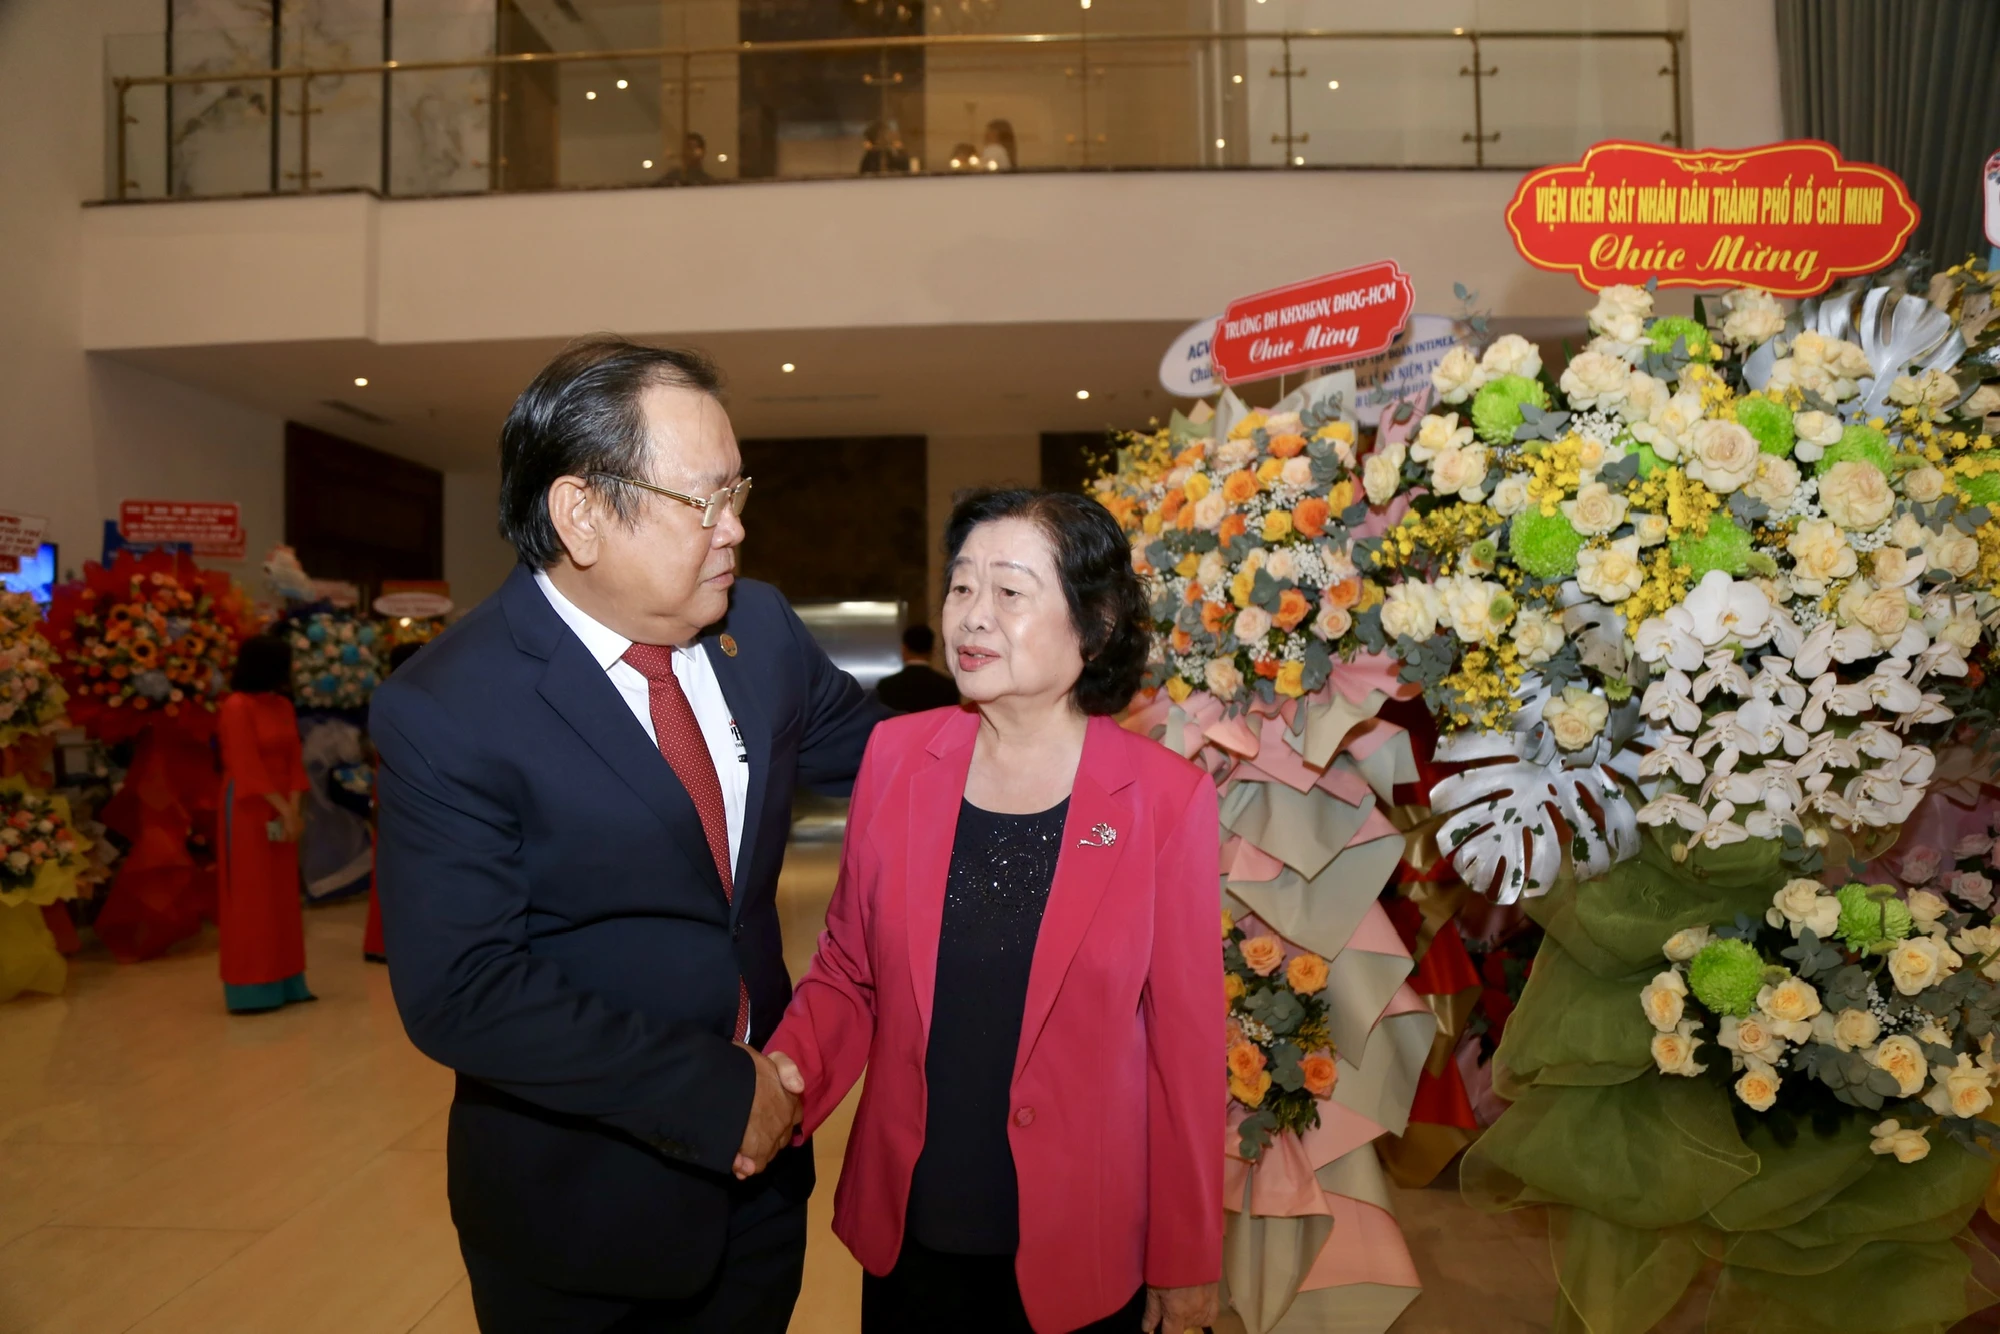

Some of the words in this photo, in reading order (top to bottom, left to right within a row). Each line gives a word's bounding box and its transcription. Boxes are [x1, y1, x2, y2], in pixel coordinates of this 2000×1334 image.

[1535, 179, 1567, 232] VIỆN
[1570, 171, 1605, 224] KIỂM
[1608, 179, 1634, 224] SÁT
[1637, 179, 1676, 224] NHÂN
[1679, 179, 1709, 225] DÂN
[1713, 179, 1758, 225] THÀNH
[1762, 173, 1793, 224] PHỐ
[1794, 173, 1815, 225] HỒ
[1816, 179, 1843, 225] CHÍ
[1844, 186, 1884, 226] MINH
[1589, 234, 1686, 272] Chúc
[1696, 234, 1820, 282] Mừng
[1264, 311, 1278, 331] ĐH
[1333, 282, 1397, 313] ĐHQG-HCM
[1248, 336, 1295, 363] Chúc
[1299, 323, 1360, 349] Mừng
[1415, 335, 1455, 353] INTIMEX
